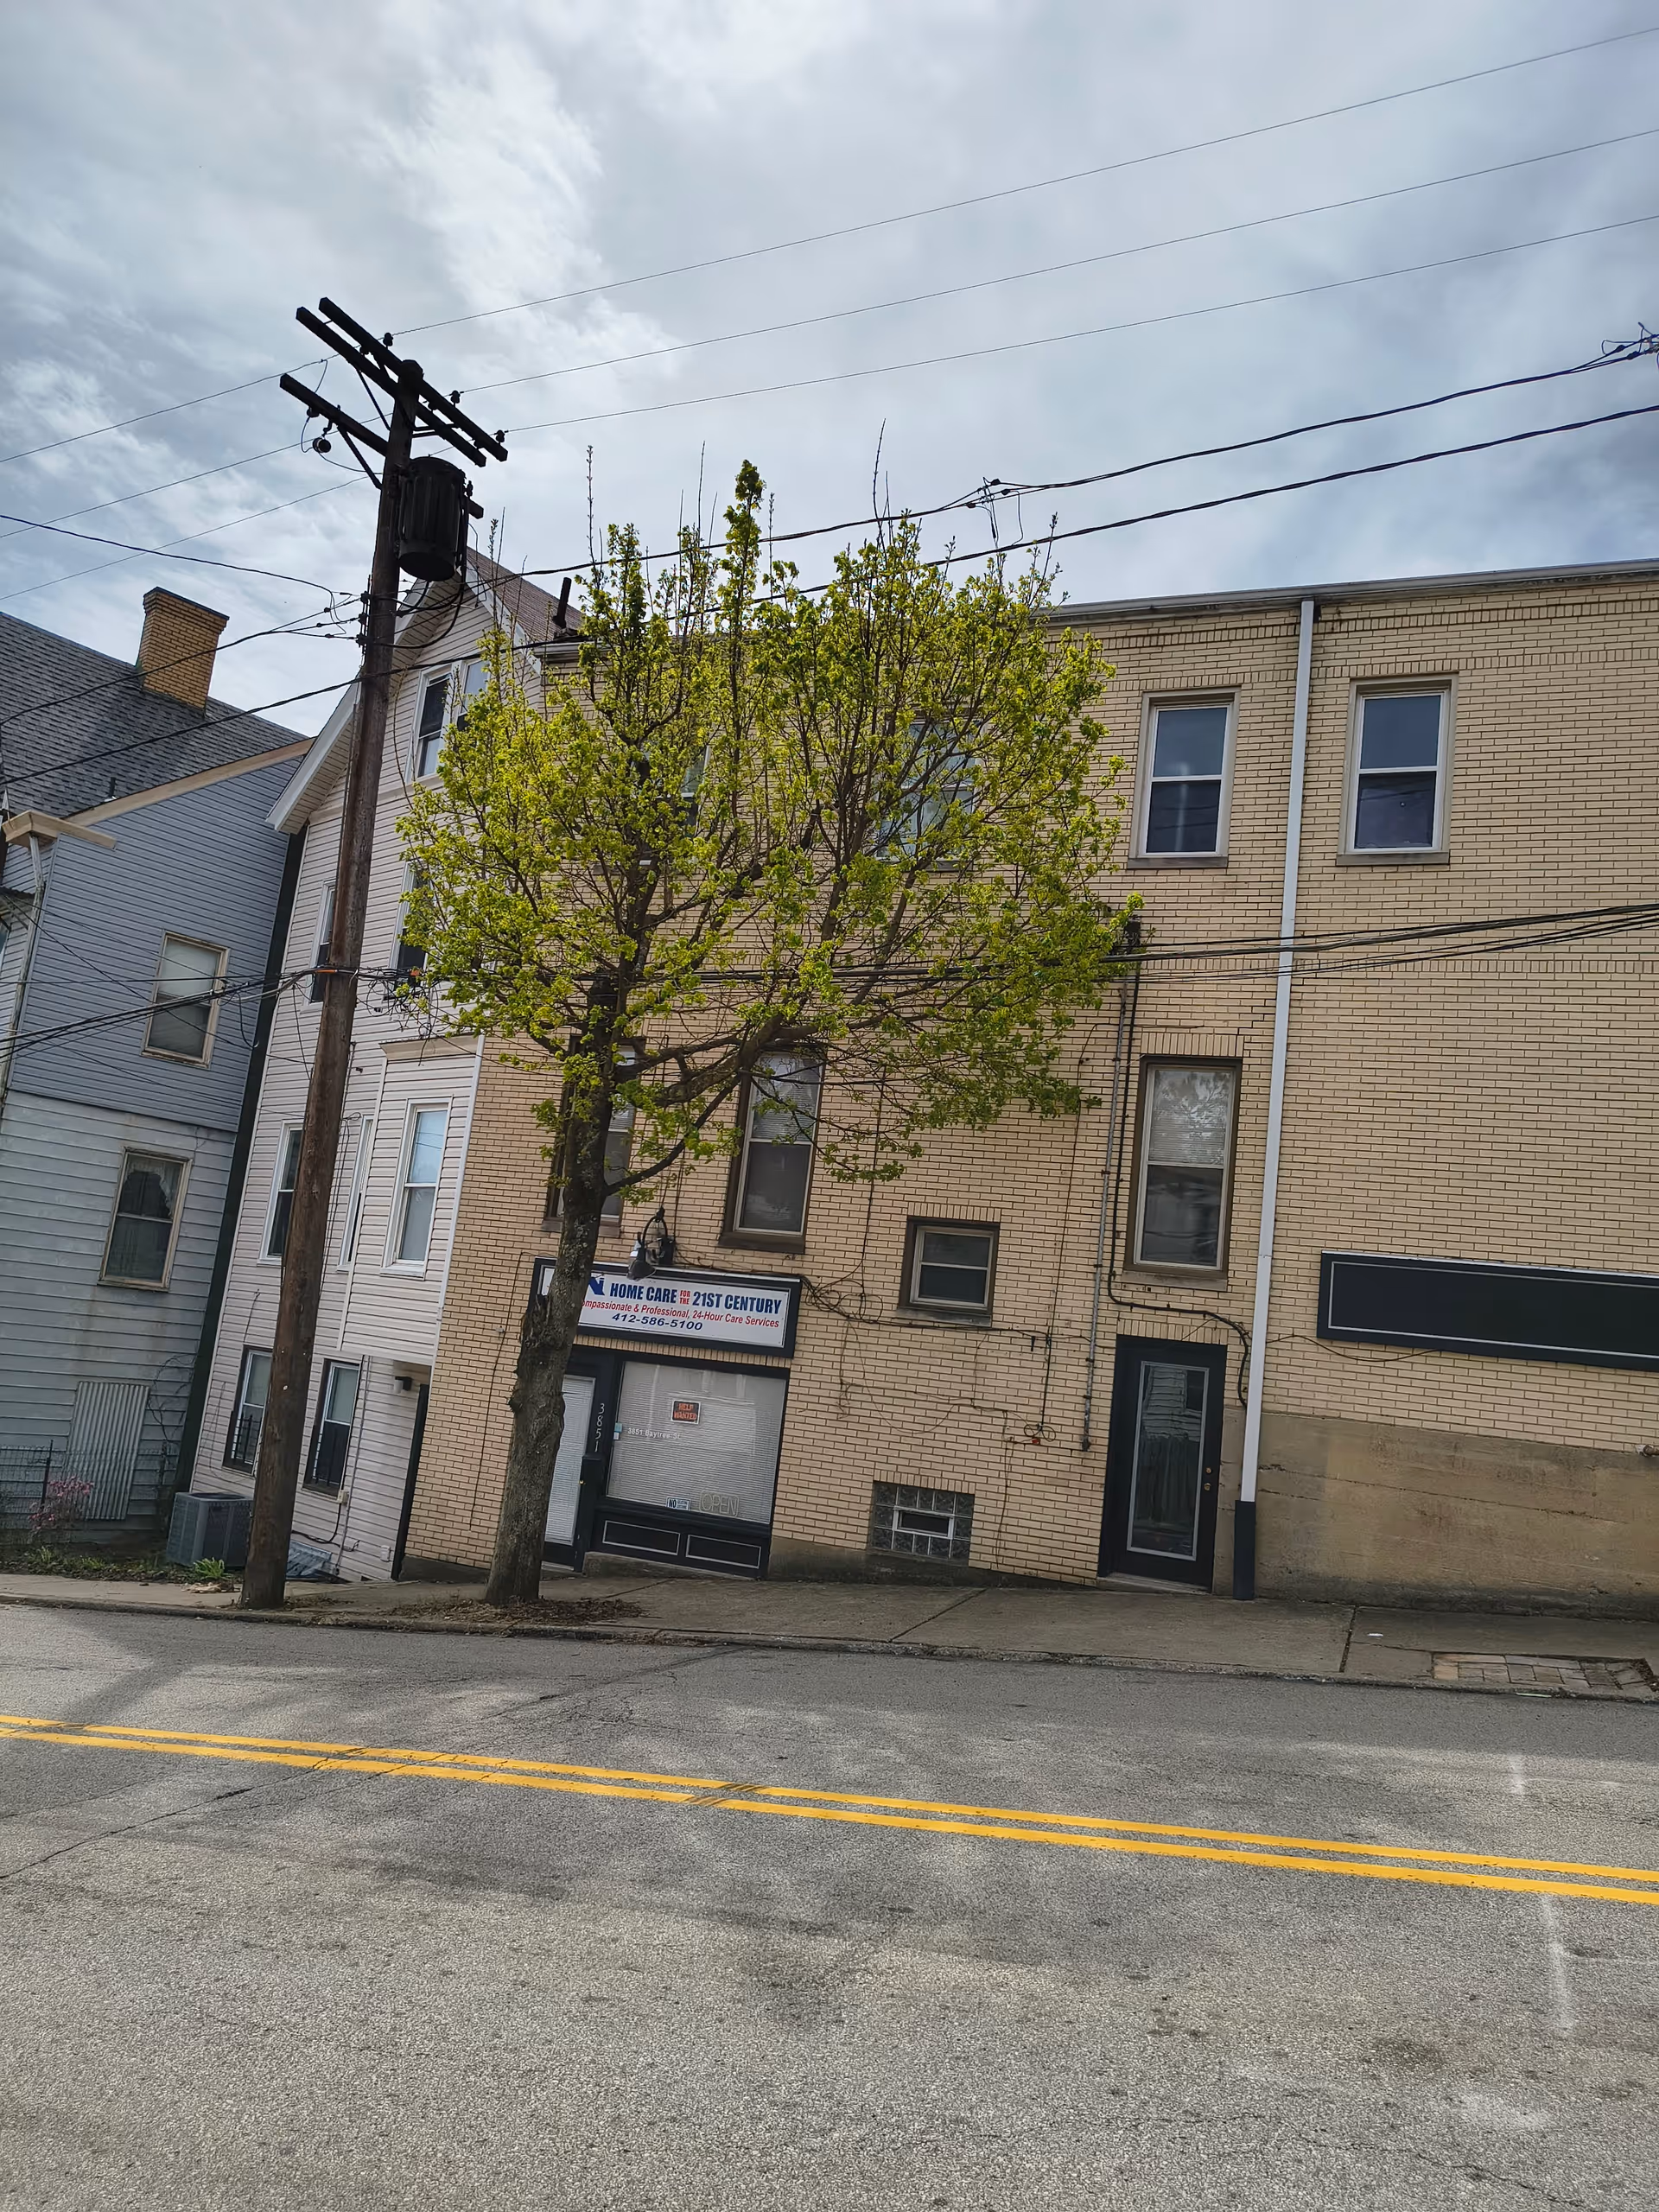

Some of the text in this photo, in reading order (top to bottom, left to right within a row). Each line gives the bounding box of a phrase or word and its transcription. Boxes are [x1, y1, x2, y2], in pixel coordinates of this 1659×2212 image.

[610, 1283, 644, 1300] HOME
[646, 1287, 677, 1303] CARE
[692, 1292, 722, 1308] 21ST
[724, 1294, 782, 1314] CENTURY
[582, 1300, 779, 1328] ompassionate & Professional, 24-Hour Care Services
[612, 1313, 702, 1331] 412-586-5100
[674, 1411, 697, 1421] WANTED
[668, 1498, 677, 1509] NO
[702, 1493, 737, 1516] OPEN
